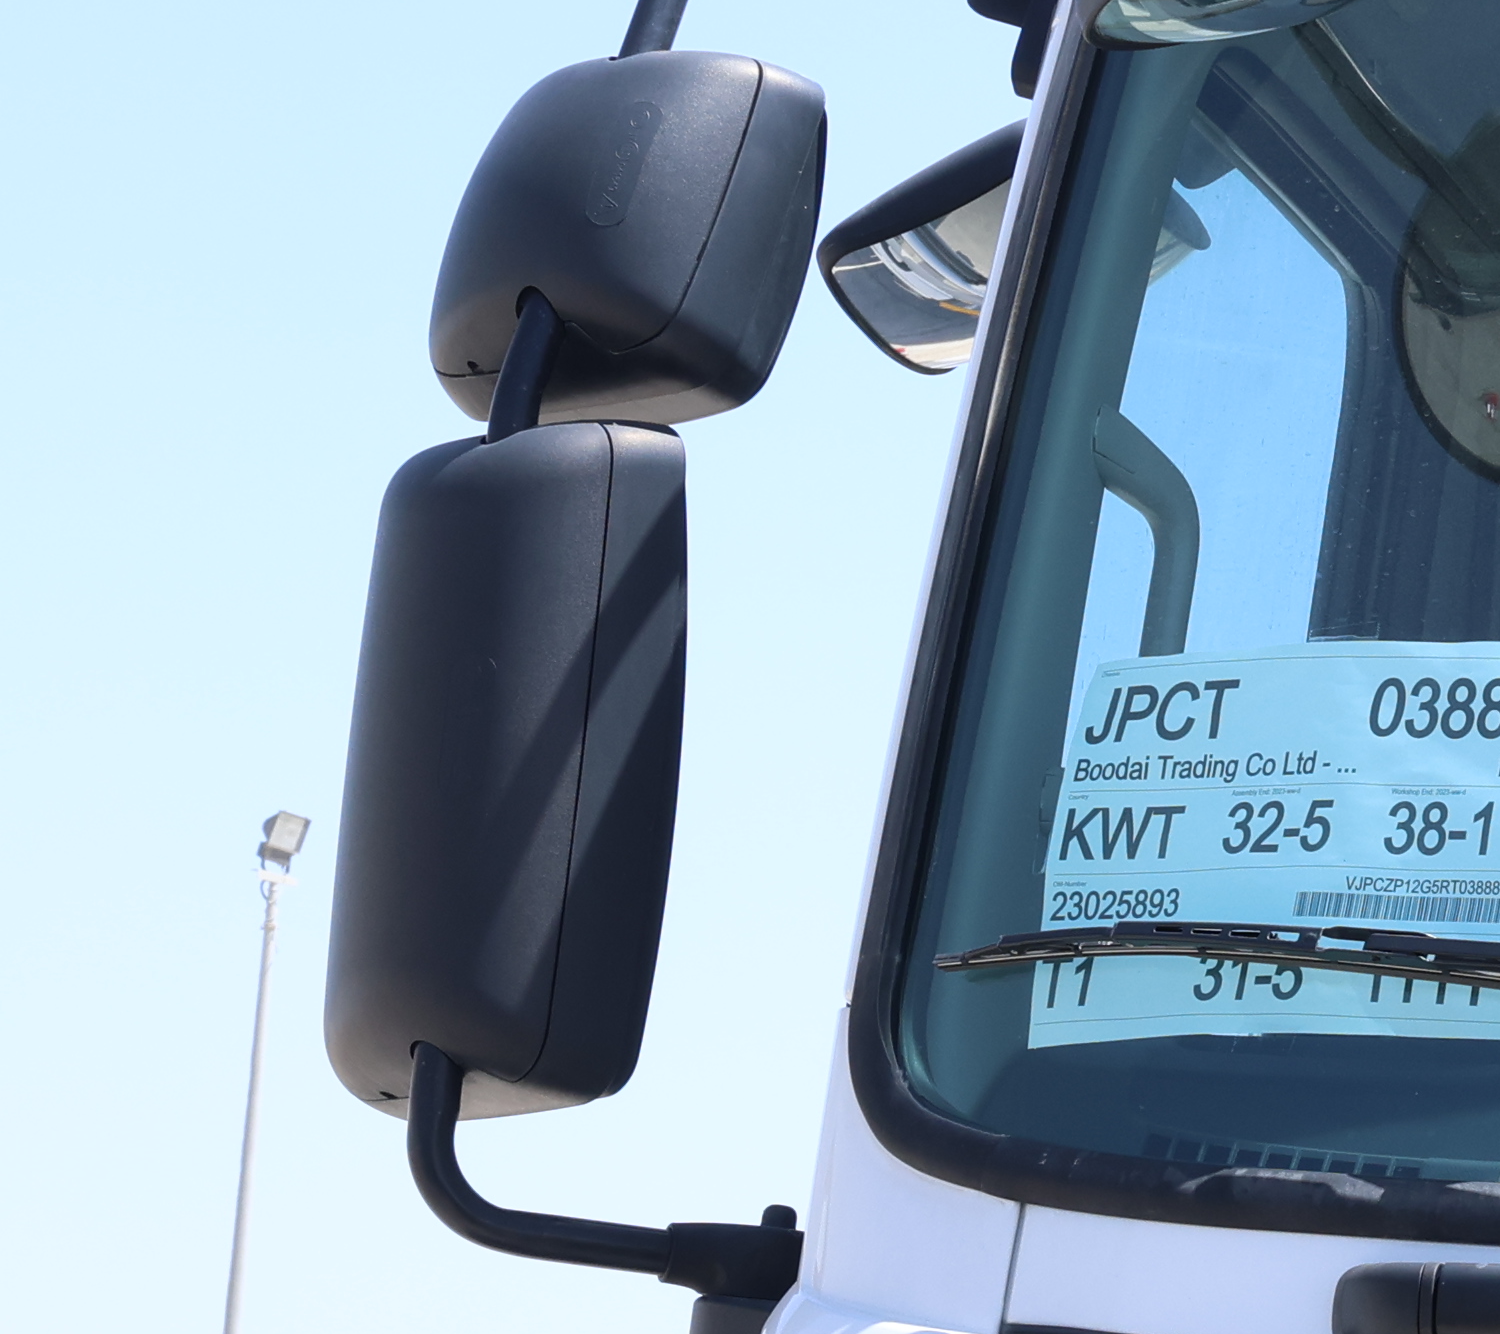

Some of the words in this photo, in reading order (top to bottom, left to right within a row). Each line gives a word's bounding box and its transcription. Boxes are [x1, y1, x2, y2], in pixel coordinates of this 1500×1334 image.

[1085, 679, 1241, 744] JPCT
[1073, 756, 1150, 782] Boodai
[1157, 754, 1239, 783] Trading
[1246, 752, 1276, 776] Co
[1282, 750, 1318, 775] Ltd
[1059, 805, 1187, 861] KWT
[1222, 799, 1334, 854] 32-5
[1383, 800, 1495, 856] 38-1
[1050, 887, 1180, 921] 23025893
